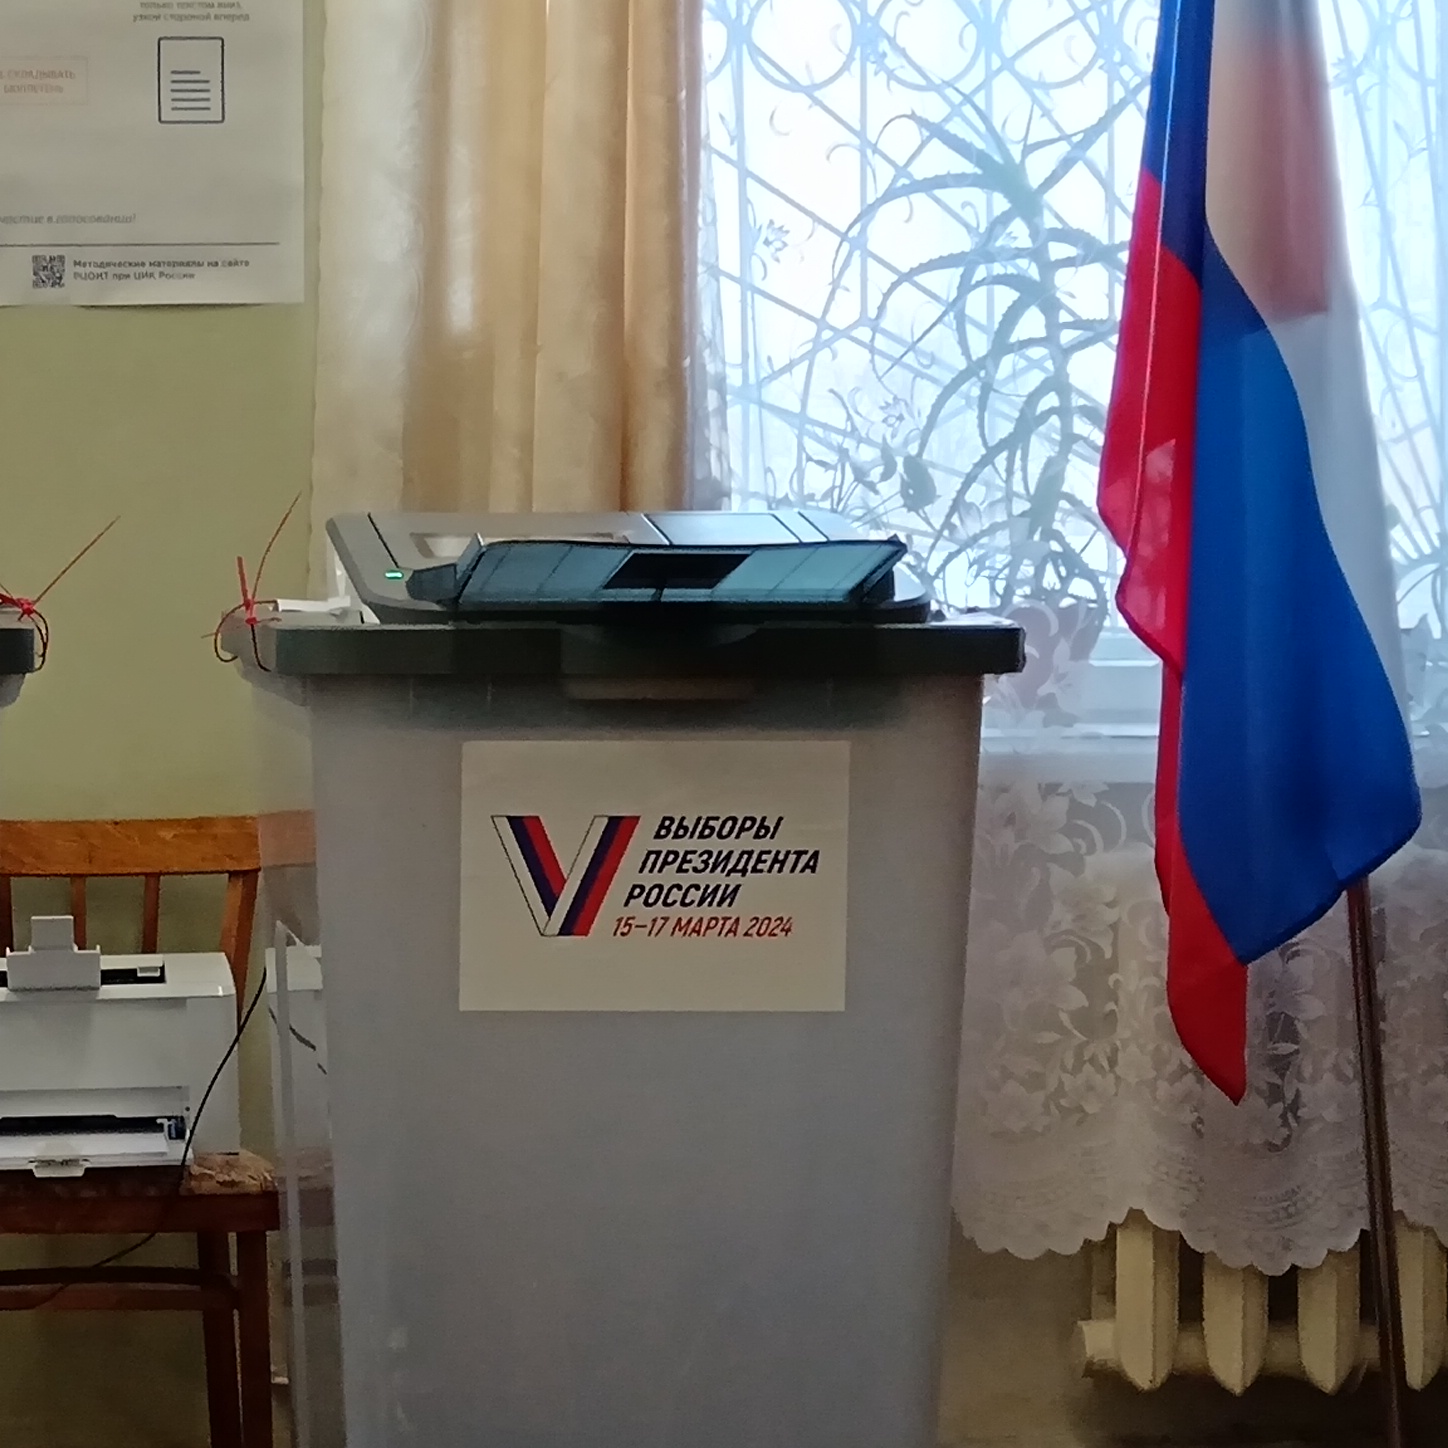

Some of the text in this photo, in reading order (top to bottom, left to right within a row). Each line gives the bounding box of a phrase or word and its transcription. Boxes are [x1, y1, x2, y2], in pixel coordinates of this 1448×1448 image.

[654, 815, 784, 840] ВЫБОРЫ
[638, 849, 821, 877] ПРЕЗИДЕНТА
[624, 883, 743, 908] РОССИИ
[670, 917, 740, 938] МАРТА
[743, 917, 794, 938] 2024
